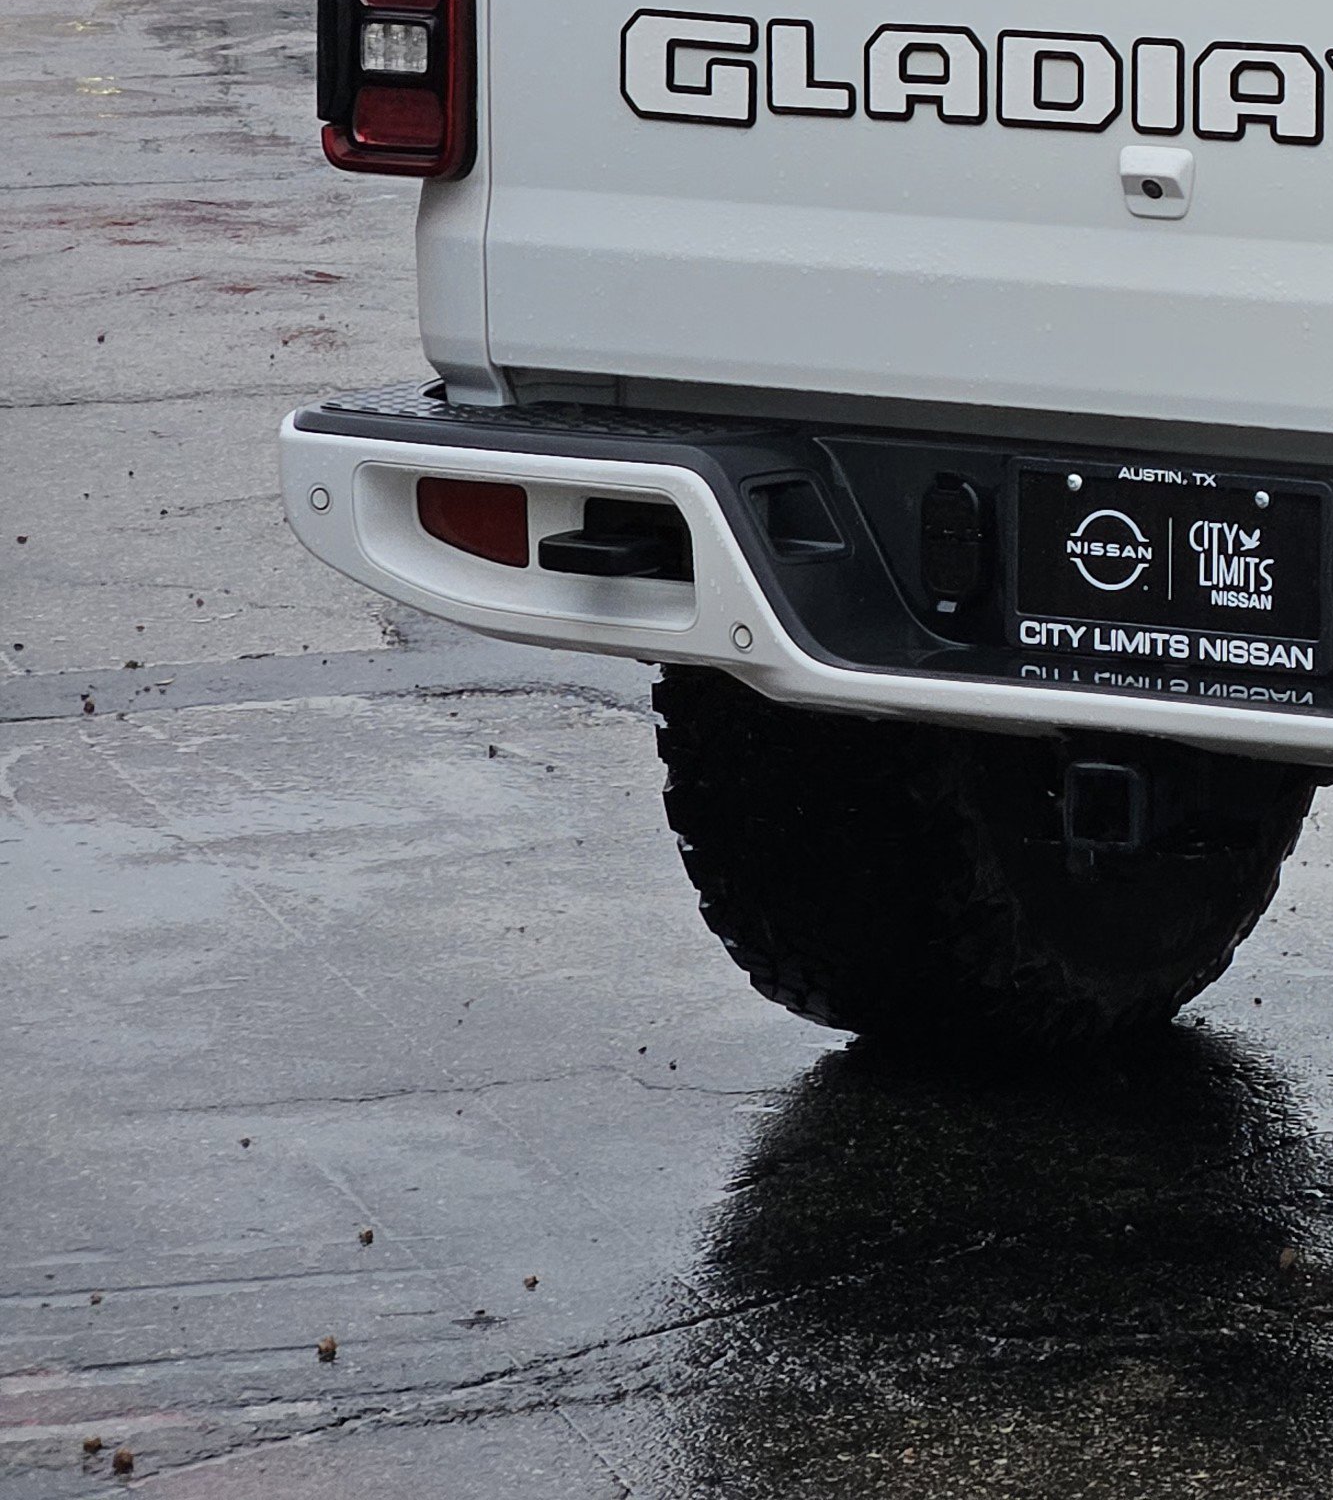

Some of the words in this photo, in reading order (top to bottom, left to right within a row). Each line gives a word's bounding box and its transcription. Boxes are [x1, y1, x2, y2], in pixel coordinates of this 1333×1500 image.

[1192, 471, 1218, 488] TX
[1189, 520, 1239, 552] CITY
[1066, 539, 1153, 561] NISSAN
[1199, 552, 1275, 593] LIMITS
[1211, 590, 1272, 610] NISSAN
[1019, 620, 1087, 650] CITY
[1094, 627, 1191, 660] LIMITS
[1199, 637, 1314, 671] NISSAN
